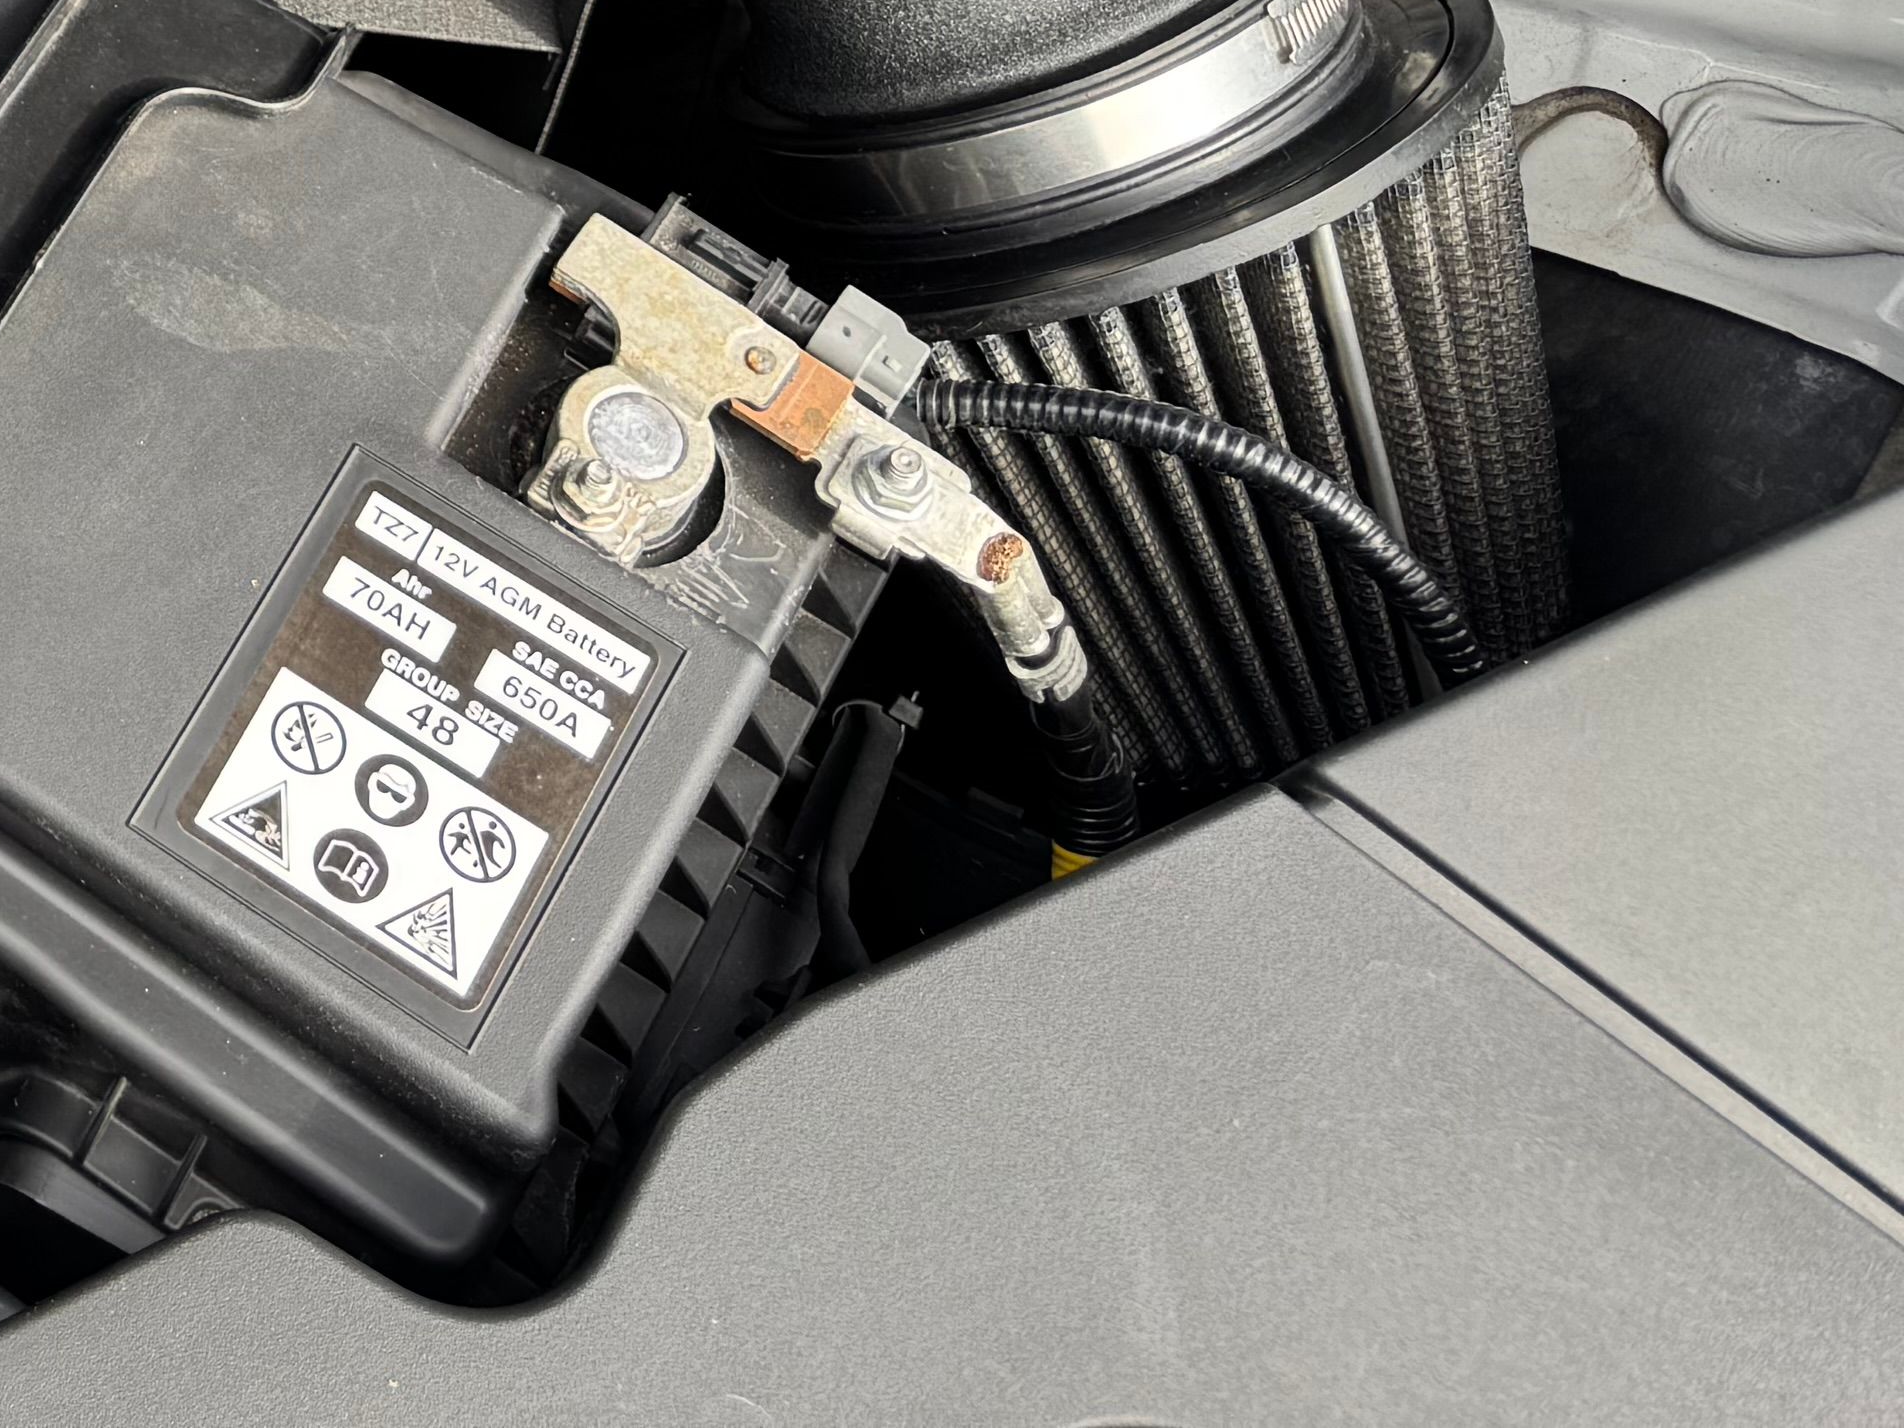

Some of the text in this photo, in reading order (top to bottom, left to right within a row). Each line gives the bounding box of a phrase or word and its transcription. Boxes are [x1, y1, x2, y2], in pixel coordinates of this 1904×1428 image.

[350, 577, 431, 640] 70AH
[373, 505, 636, 679] TZ7 12V AGM Battery
[391, 568, 433, 600] Ahr
[380, 648, 519, 744] GROUP SIZE
[502, 675, 578, 738] 650A
[512, 640, 606, 710] SAE CCA
[405, 703, 459, 747] 48
